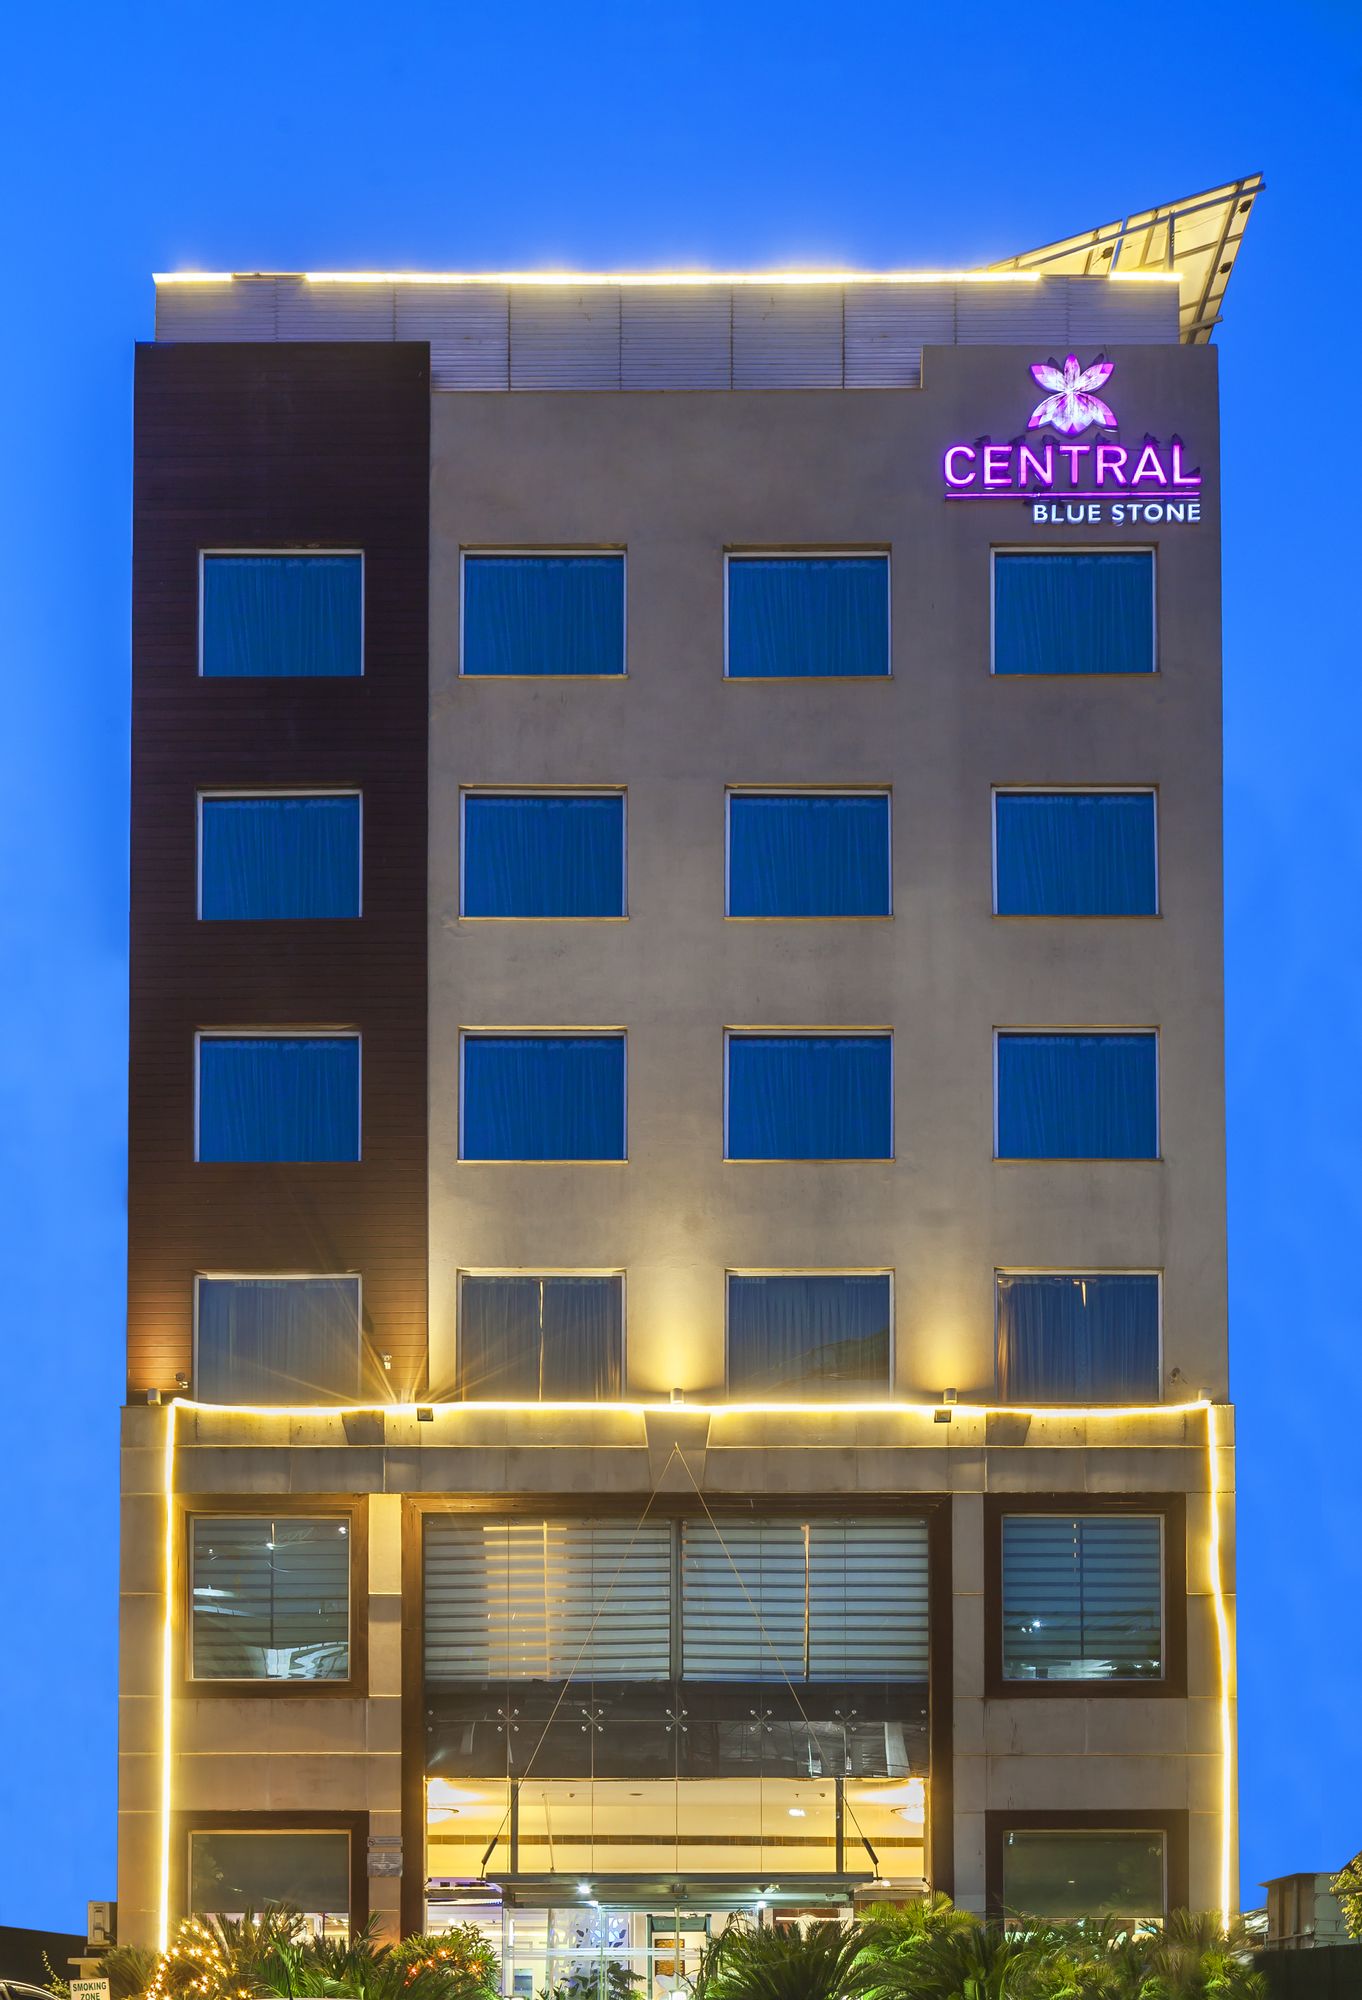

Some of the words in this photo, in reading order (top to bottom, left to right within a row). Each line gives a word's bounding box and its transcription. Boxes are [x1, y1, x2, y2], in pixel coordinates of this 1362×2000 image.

[944, 445, 1201, 486] CENTRAL
[1033, 504, 1101, 523] BLUE
[1112, 503, 1201, 524] STONE
[72, 1982, 107, 1992] SMOKING
[80, 1992, 100, 2000] ZONE
